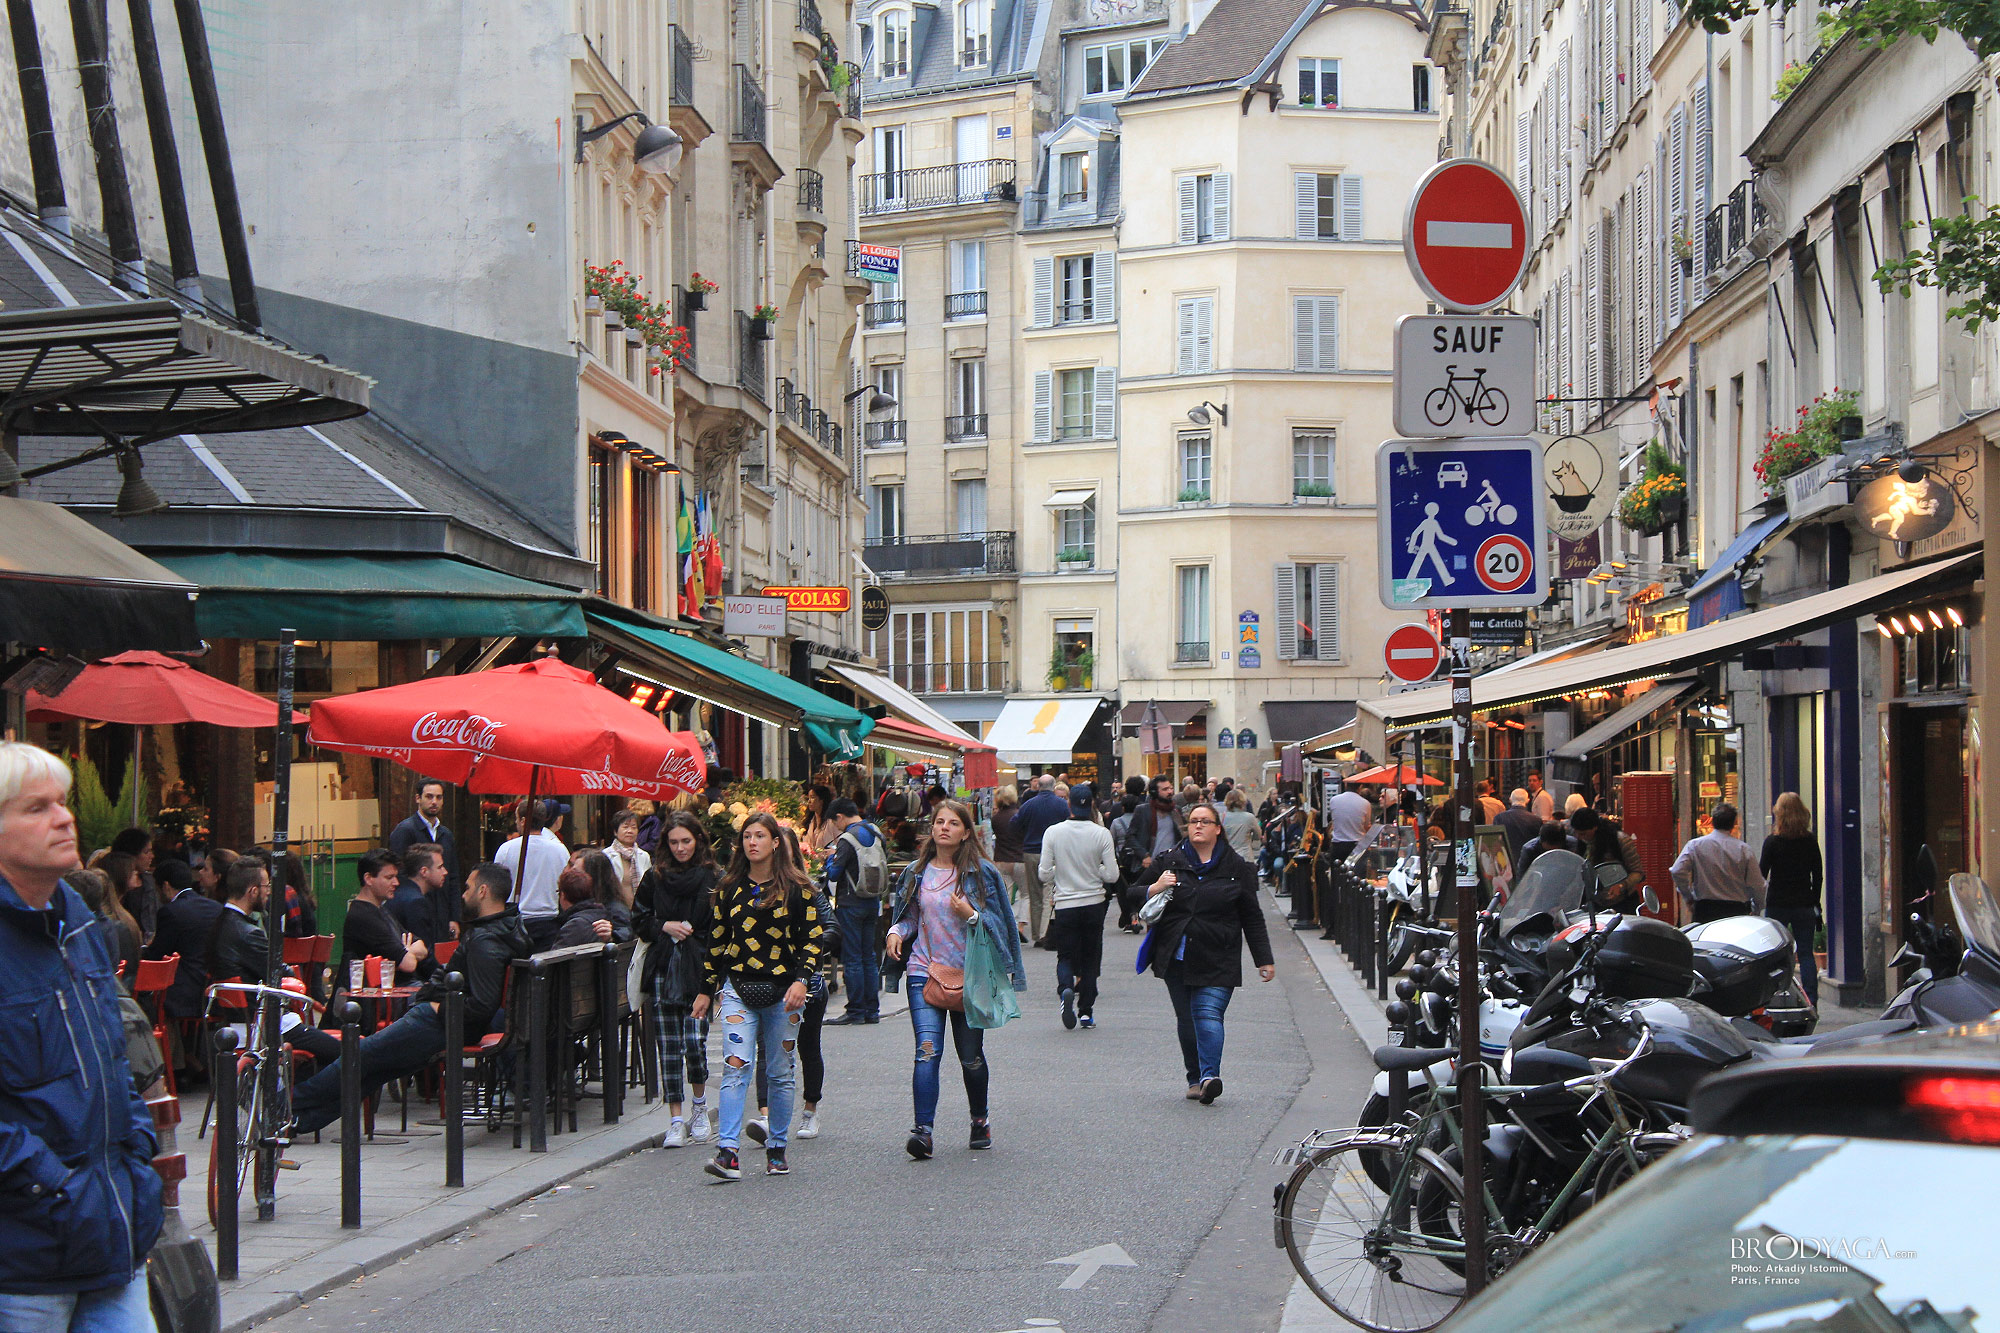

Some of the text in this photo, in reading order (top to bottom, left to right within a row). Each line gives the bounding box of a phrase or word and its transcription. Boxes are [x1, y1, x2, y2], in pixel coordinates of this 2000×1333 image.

[870, 247, 898, 257] LOUER
[861, 255, 898, 268] FONCIA
[1433, 325, 1504, 353] SAUF
[1573, 539, 1587, 553] de
[1488, 553, 1519, 574] 20
[1564, 555, 1597, 570] Paris
[758, 604, 783, 615] ELLE
[862, 600, 886, 609] PAUL
[411, 711, 507, 751] Coca-Cola
